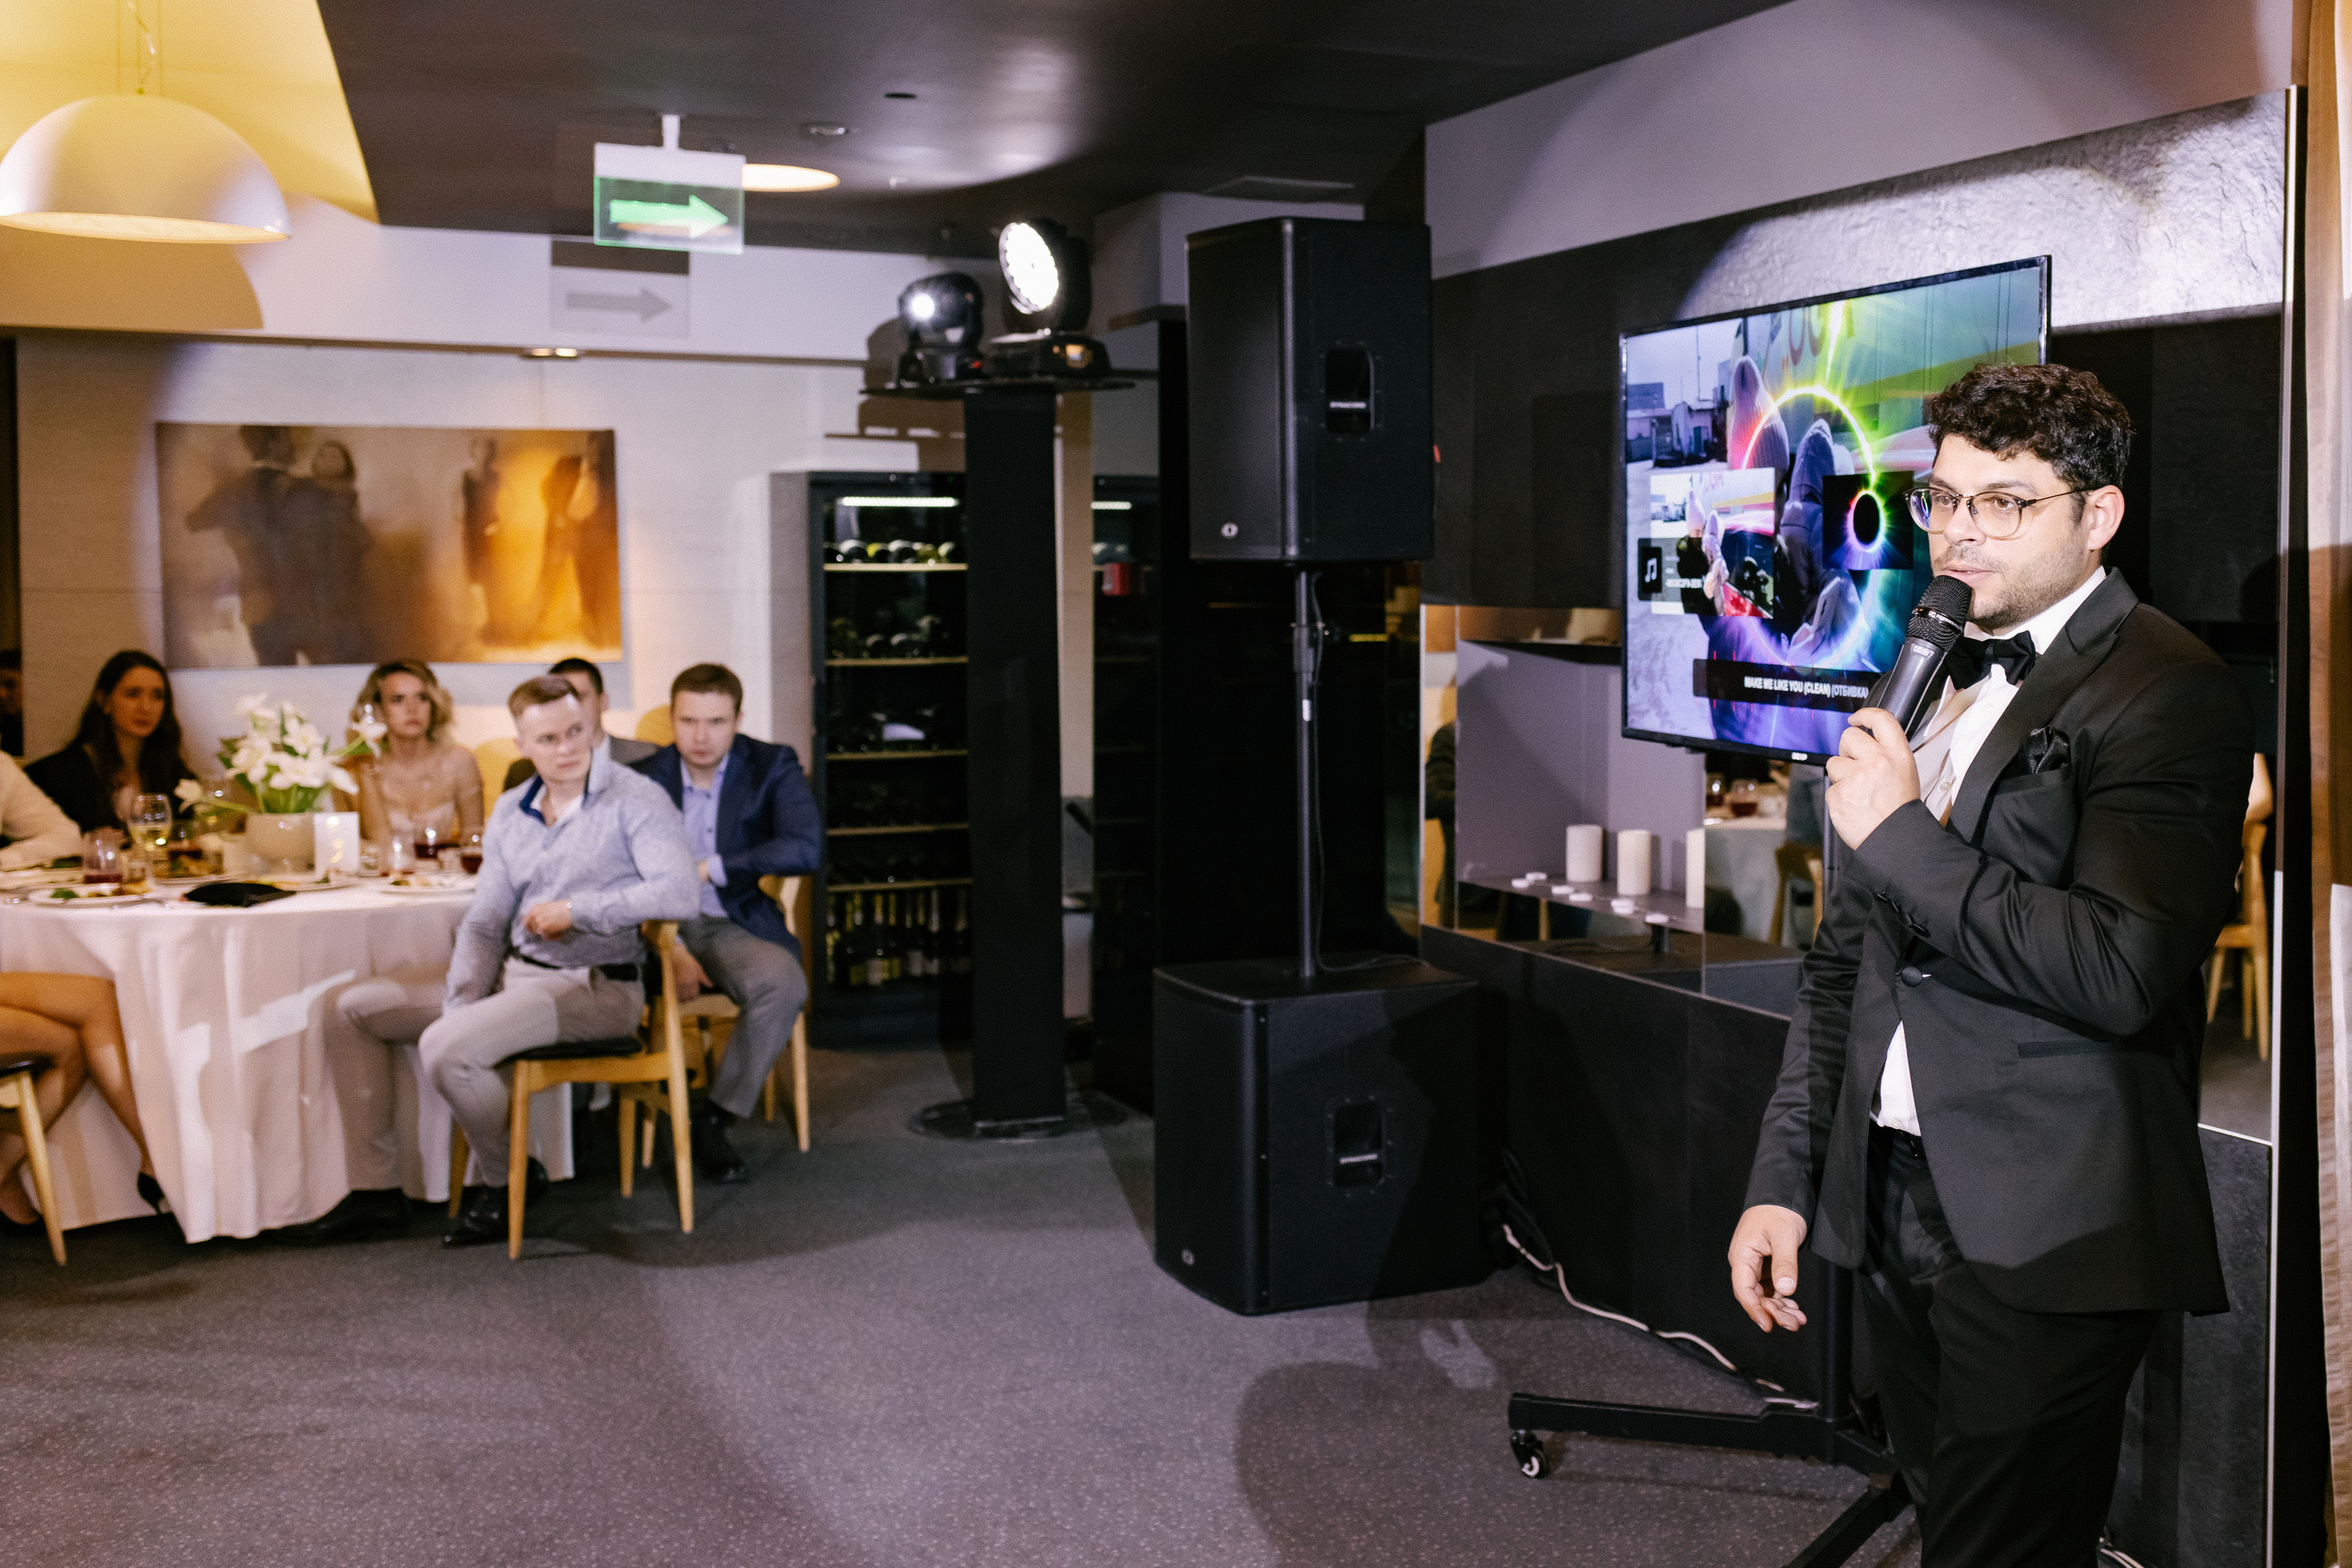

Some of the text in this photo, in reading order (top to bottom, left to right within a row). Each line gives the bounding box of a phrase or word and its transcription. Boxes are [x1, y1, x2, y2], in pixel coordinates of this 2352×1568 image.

[1744, 676, 1763, 689] MAKE
[1764, 677, 1773, 690] ME
[1774, 679, 1789, 692] LIKE
[1789, 681, 1804, 694] YOU
[1804, 682, 1831, 698] (CLEAN)
